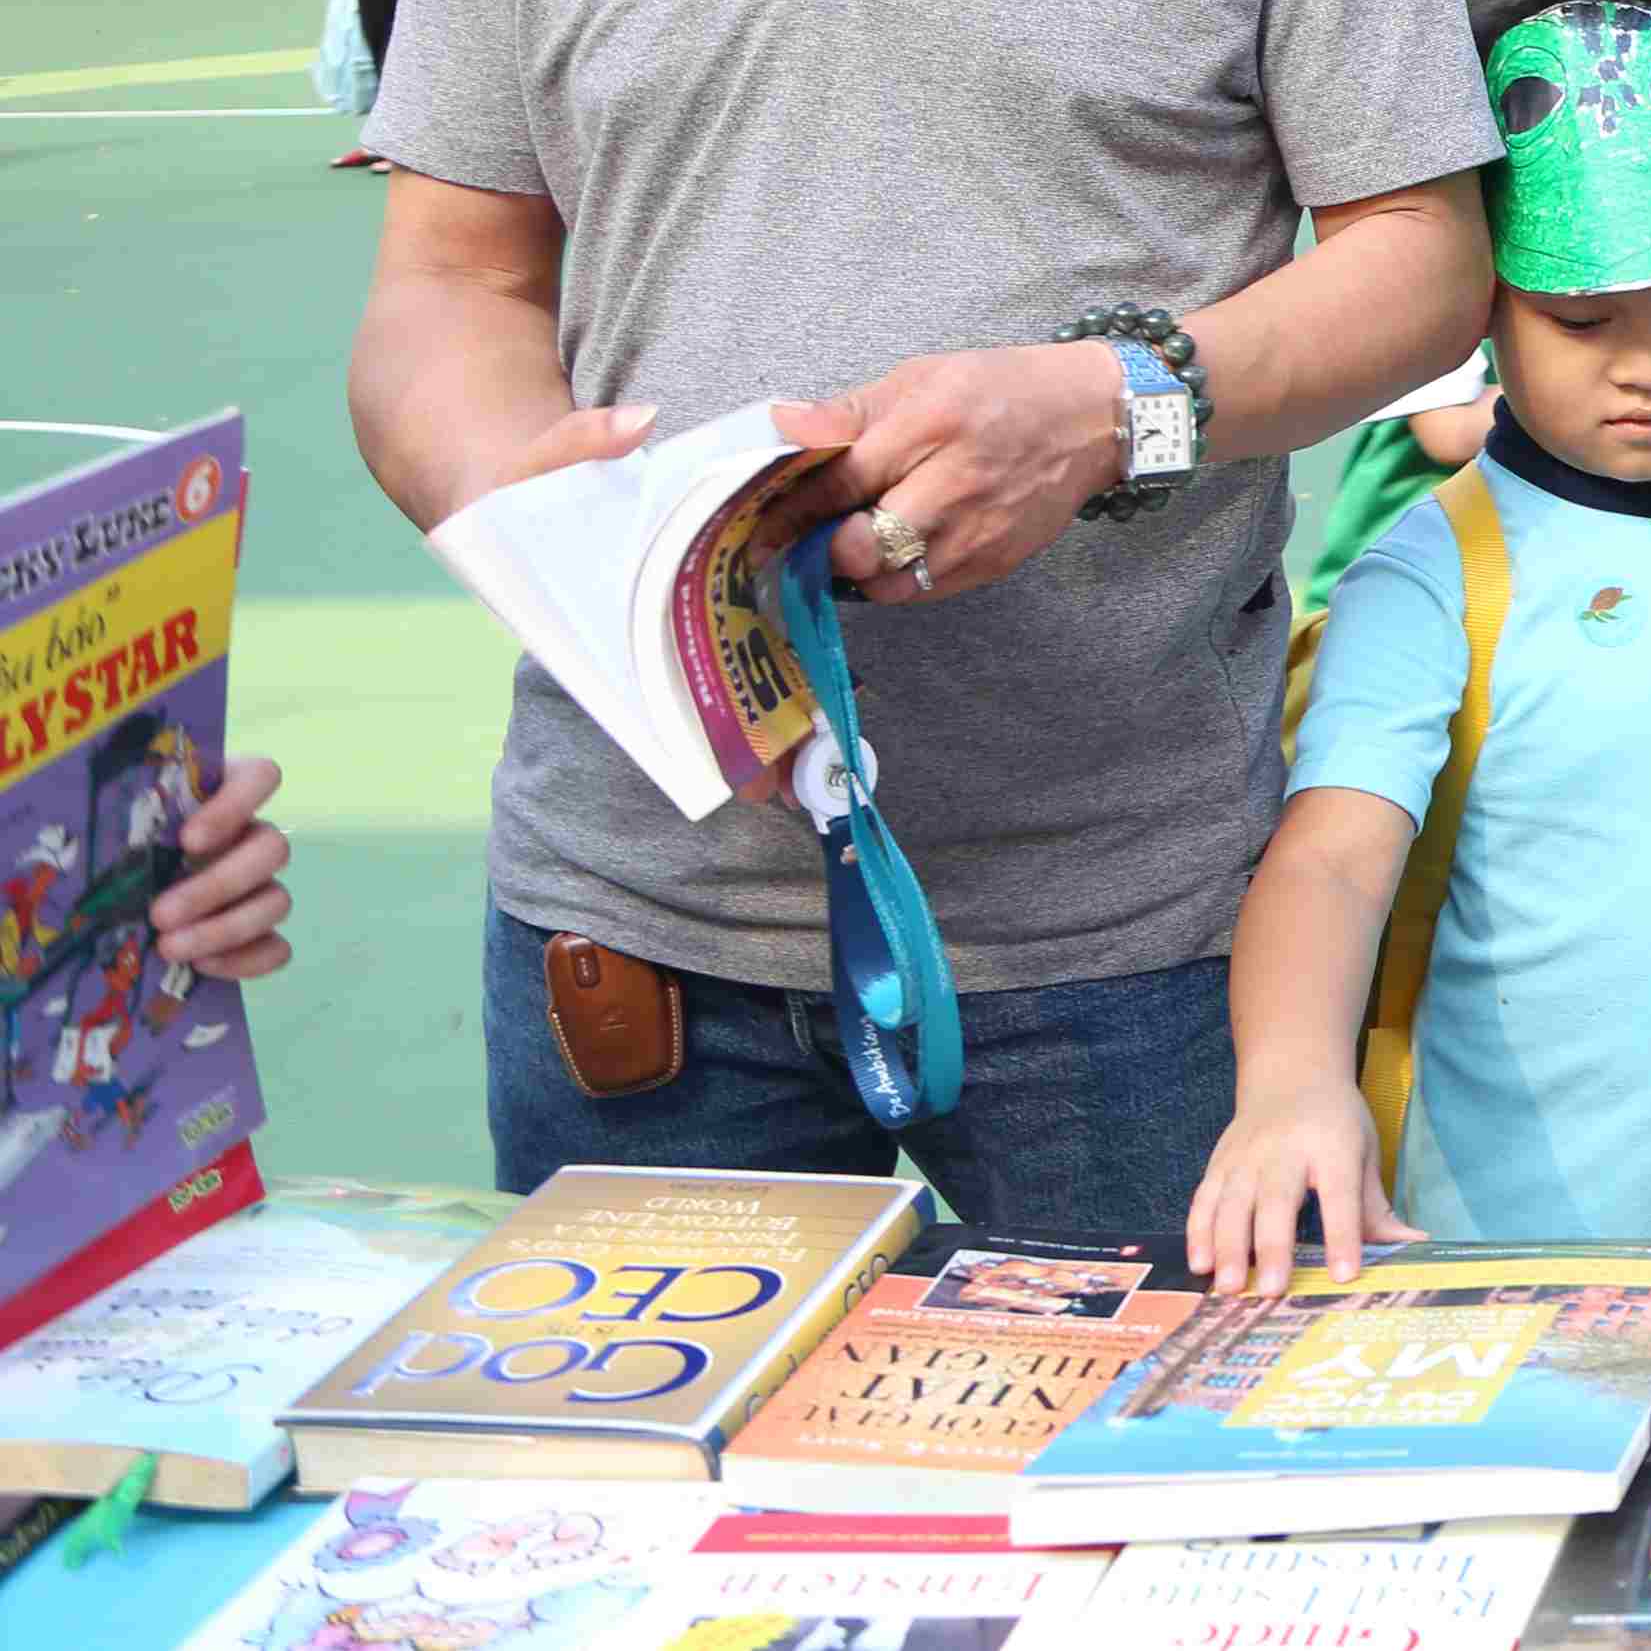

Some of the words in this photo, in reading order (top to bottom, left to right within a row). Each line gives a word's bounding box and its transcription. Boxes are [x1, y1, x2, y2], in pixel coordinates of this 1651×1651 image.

[186, 457, 215, 515] 6
[641, 1196, 762, 1215] WORLD
[450, 1258, 783, 1324] CEO
[352, 1331, 712, 1404] God
